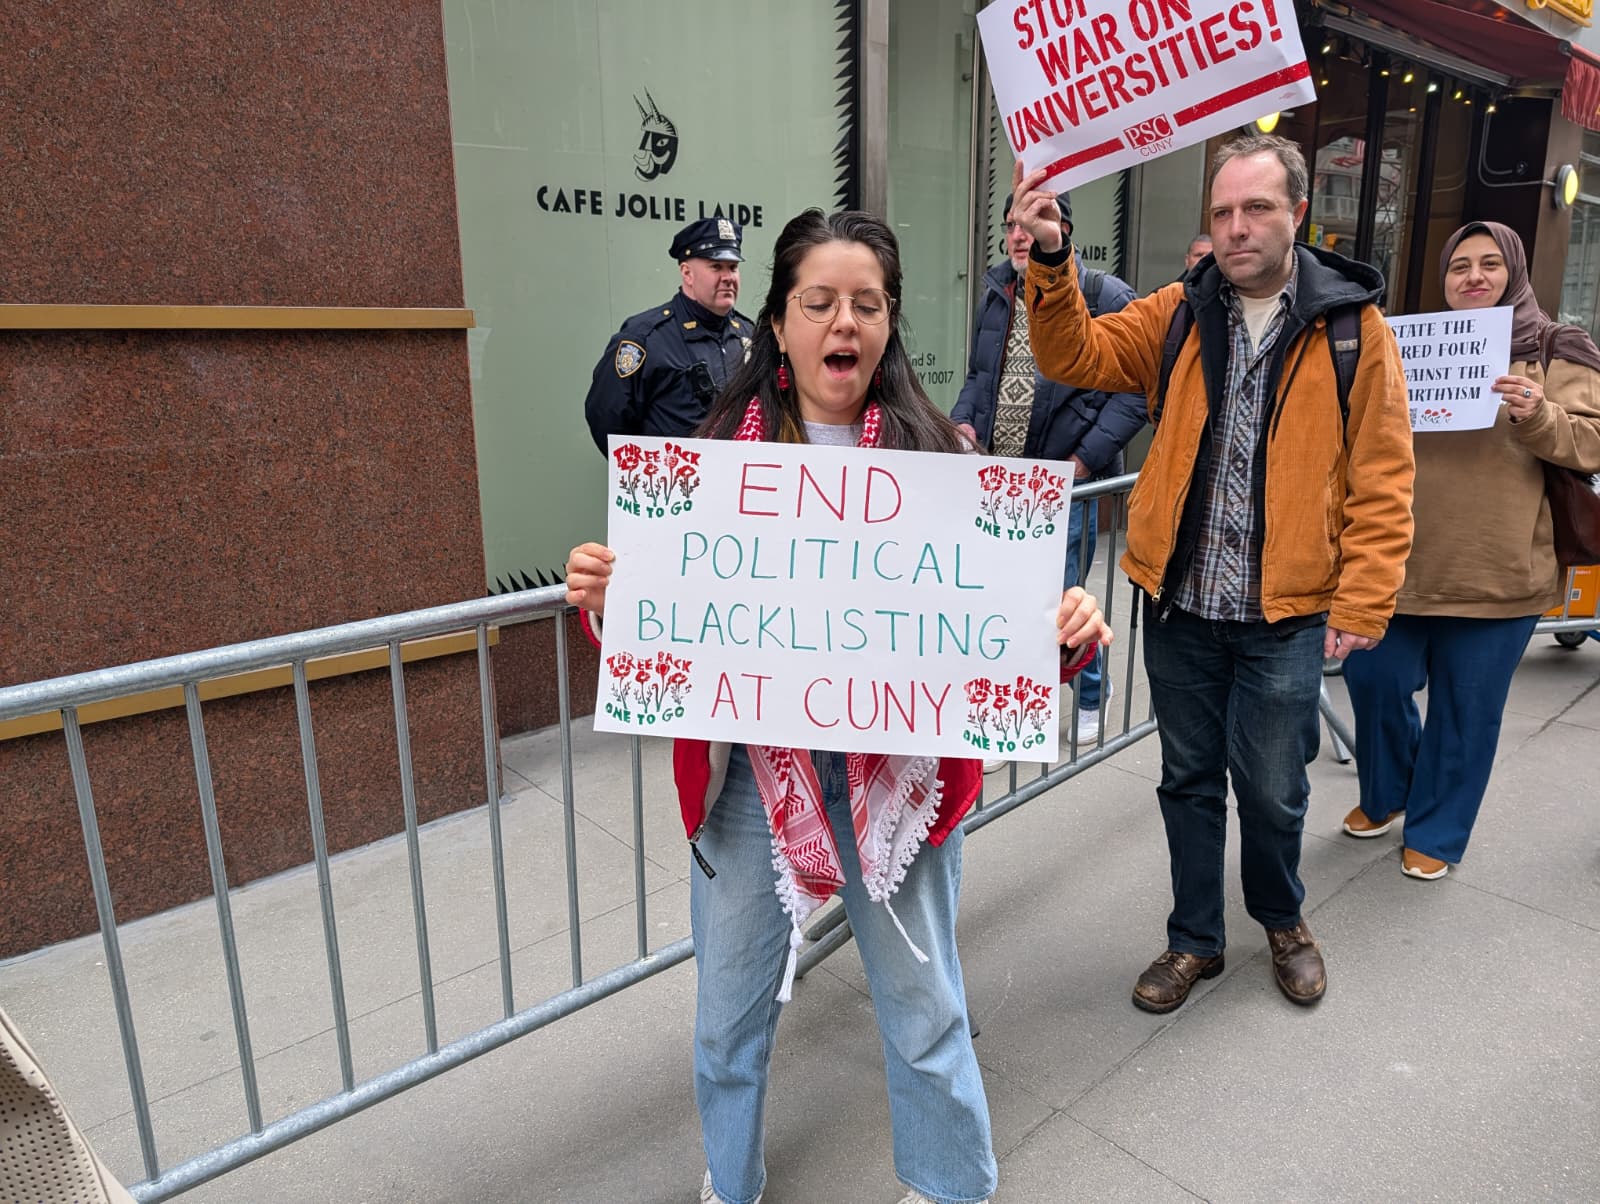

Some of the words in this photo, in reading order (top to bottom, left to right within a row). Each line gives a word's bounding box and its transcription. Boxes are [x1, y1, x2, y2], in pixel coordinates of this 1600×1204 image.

[1036, 13, 1126, 87] WAR
[1129, 0, 1193, 41] ON
[1007, 0, 1283, 152] UNIVERSITIES!
[1125, 116, 1171, 148] PSC
[1140, 137, 1173, 157] CUNY
[537, 185, 603, 216] CAFE
[615, 193, 686, 223] JOLIE
[699, 200, 763, 228] LAIDE
[1081, 246, 1107, 260] AIDE
[1442, 319, 1477, 335] THE
[926, 352, 936, 367] St
[1438, 338, 1487, 357] FOUR!
[928, 370, 954, 385] 10017
[1458, 364, 1490, 380] THE
[613, 443, 661, 468] THREE
[978, 464, 1026, 488] THREE
[1032, 464, 1066, 489] BACK
[739, 463, 902, 524] END
[616, 495, 640, 516] ONE
[646, 506, 664, 518] TO
[670, 500, 692, 515] GO
[975, 516, 1000, 538] ONE
[1007, 529, 1025, 540] TO
[1032, 523, 1055, 538] GO
[681, 531, 985, 589] POLITICAL
[638, 599, 1011, 660] BLACKLISTING
[658, 651, 692, 672] BACK
[964, 677, 1011, 701] THREE
[605, 702, 631, 723] ONE
[637, 714, 656, 725] TO
[662, 706, 685, 722] GO
[711, 671, 773, 721] AT
[804, 677, 952, 736] CUNY
[963, 729, 990, 750] ONE
[996, 741, 1016, 752] TO
[1022, 732, 1046, 749] GO
